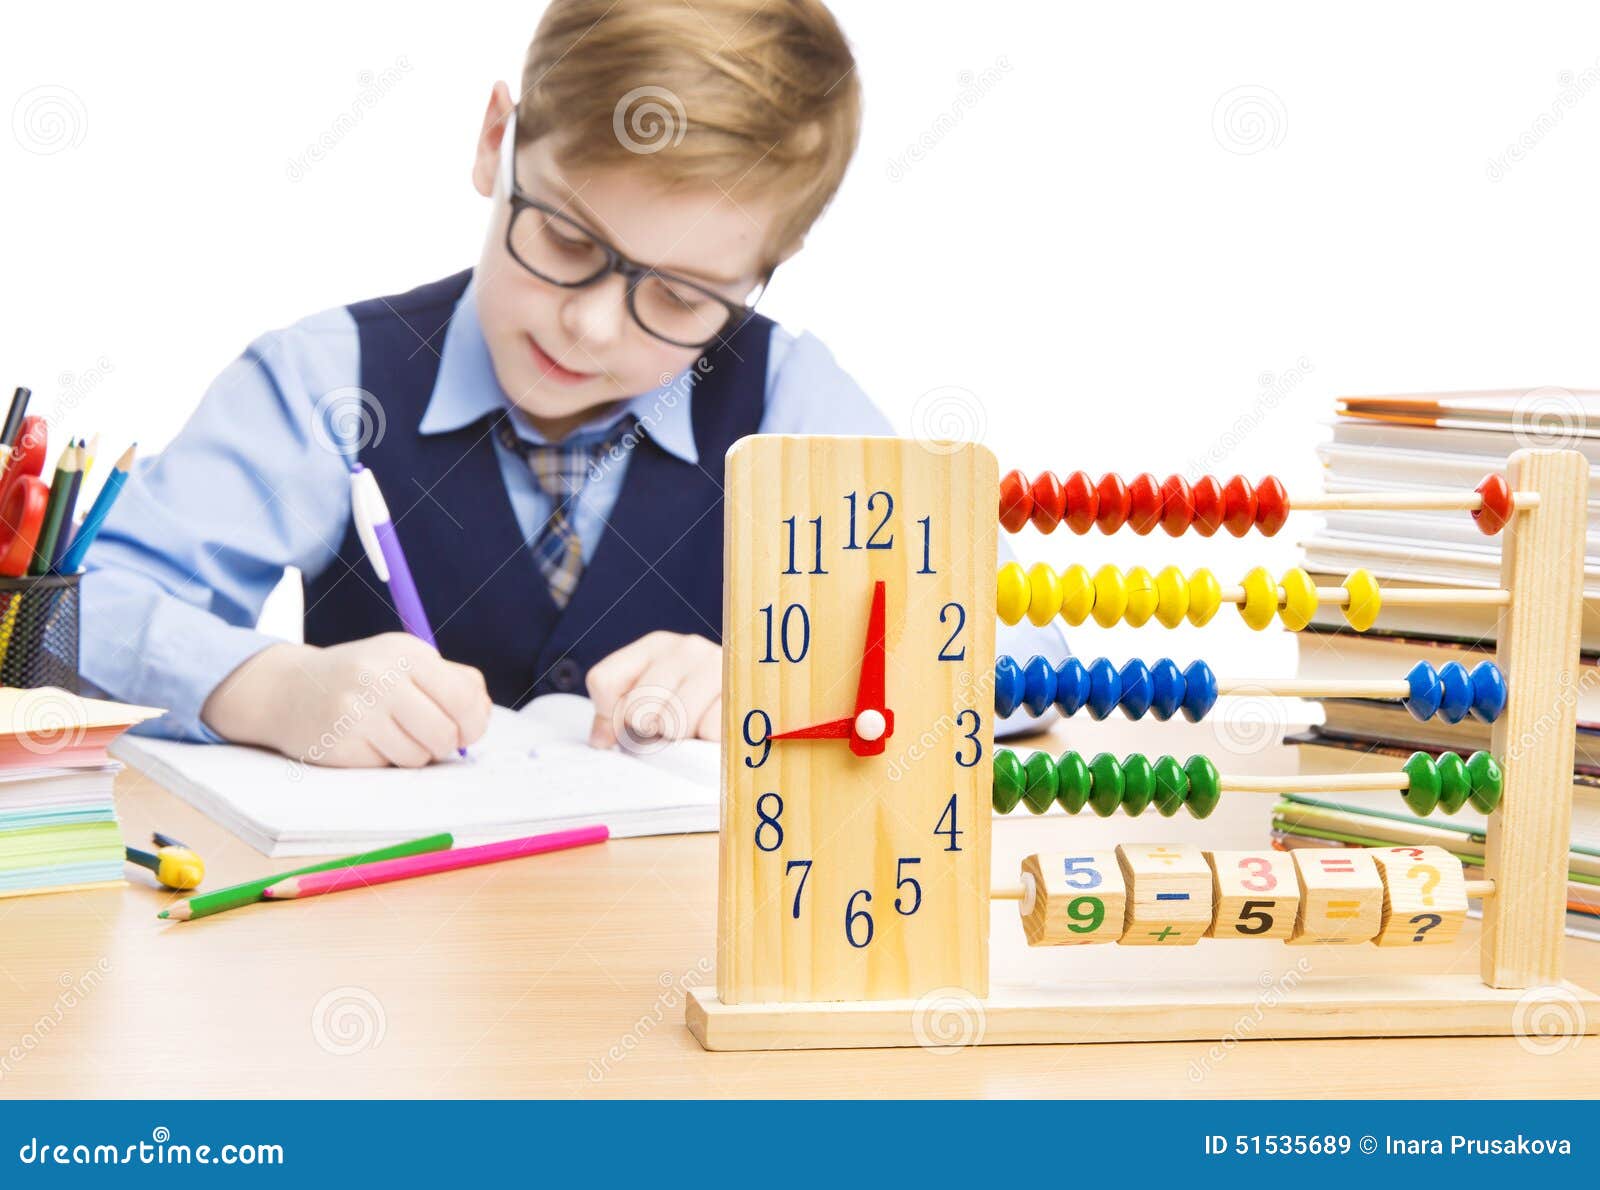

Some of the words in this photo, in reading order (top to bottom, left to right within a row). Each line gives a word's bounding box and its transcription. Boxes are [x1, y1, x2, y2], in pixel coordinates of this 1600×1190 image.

[782, 516, 829, 575] 11
[842, 491, 894, 550] 12
[916, 516, 936, 575] 1
[759, 603, 810, 663] 10
[938, 602, 966, 661] 2
[743, 709, 772, 768] 9
[955, 709, 982, 767] 3
[754, 793, 784, 852] 8
[934, 794, 963, 851] 4
[785, 860, 813, 919] 7
[895, 858, 922, 915] 5
[1064, 857, 1102, 889] 5
[1238, 857, 1278, 892] 3
[845, 890, 874, 948] 6
[1067, 896, 1105, 934] 9
[1235, 901, 1276, 935] 5
